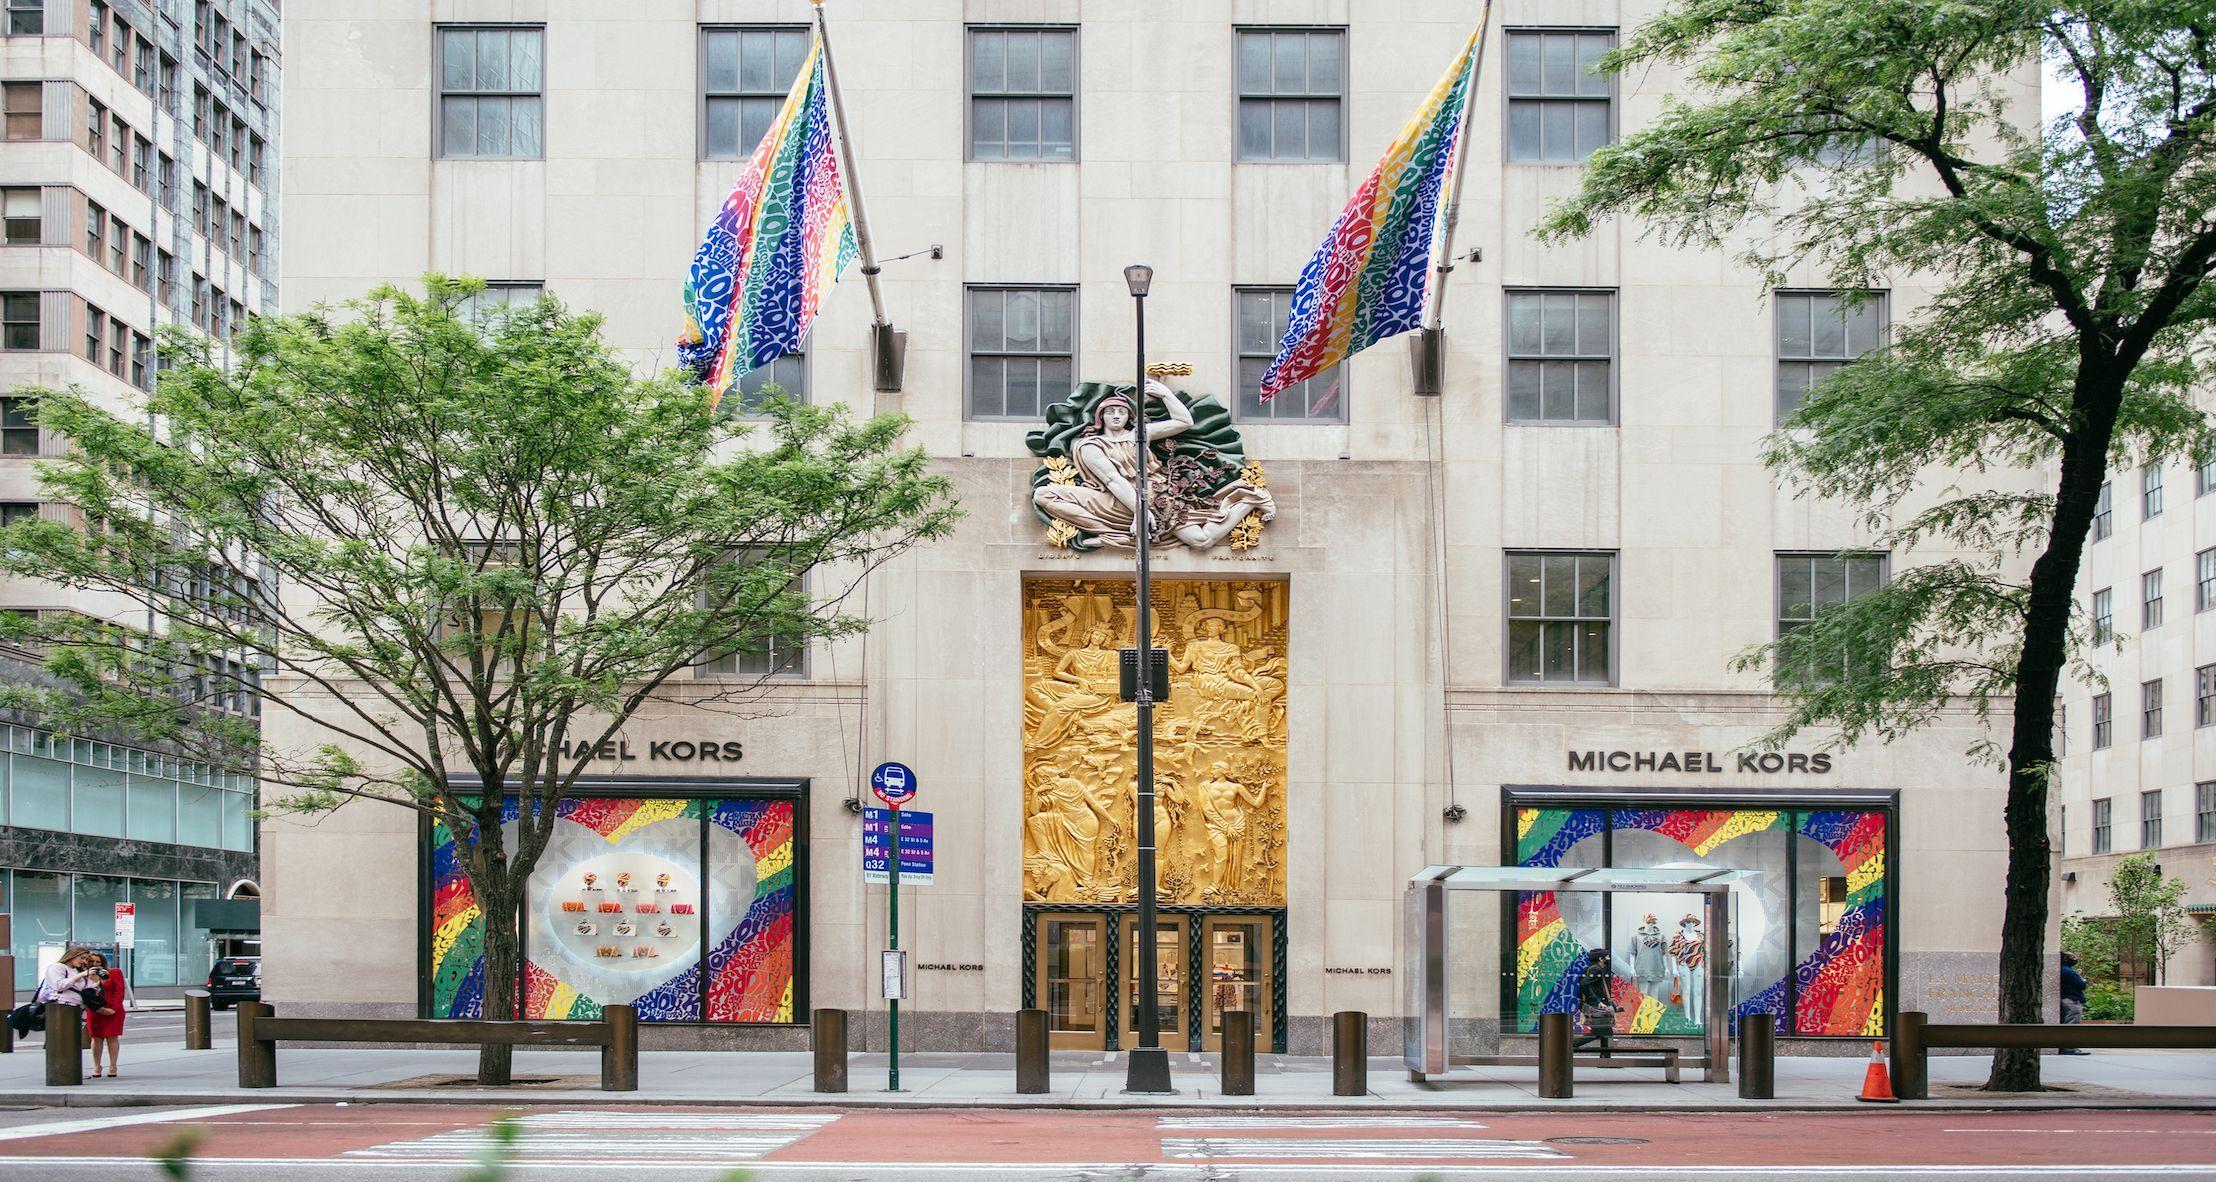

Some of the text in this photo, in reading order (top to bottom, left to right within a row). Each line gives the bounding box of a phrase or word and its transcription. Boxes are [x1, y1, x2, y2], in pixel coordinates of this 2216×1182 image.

[650, 741, 743, 762] KORS
[1567, 750, 1833, 774] MICHAEL KORS
[877, 790, 886, 798] NO
[865, 810, 878, 819] M1
[865, 822, 878, 832] M1
[865, 835, 878, 844] M4
[865, 847, 880, 857] M4
[865, 860, 885, 870] Q32
